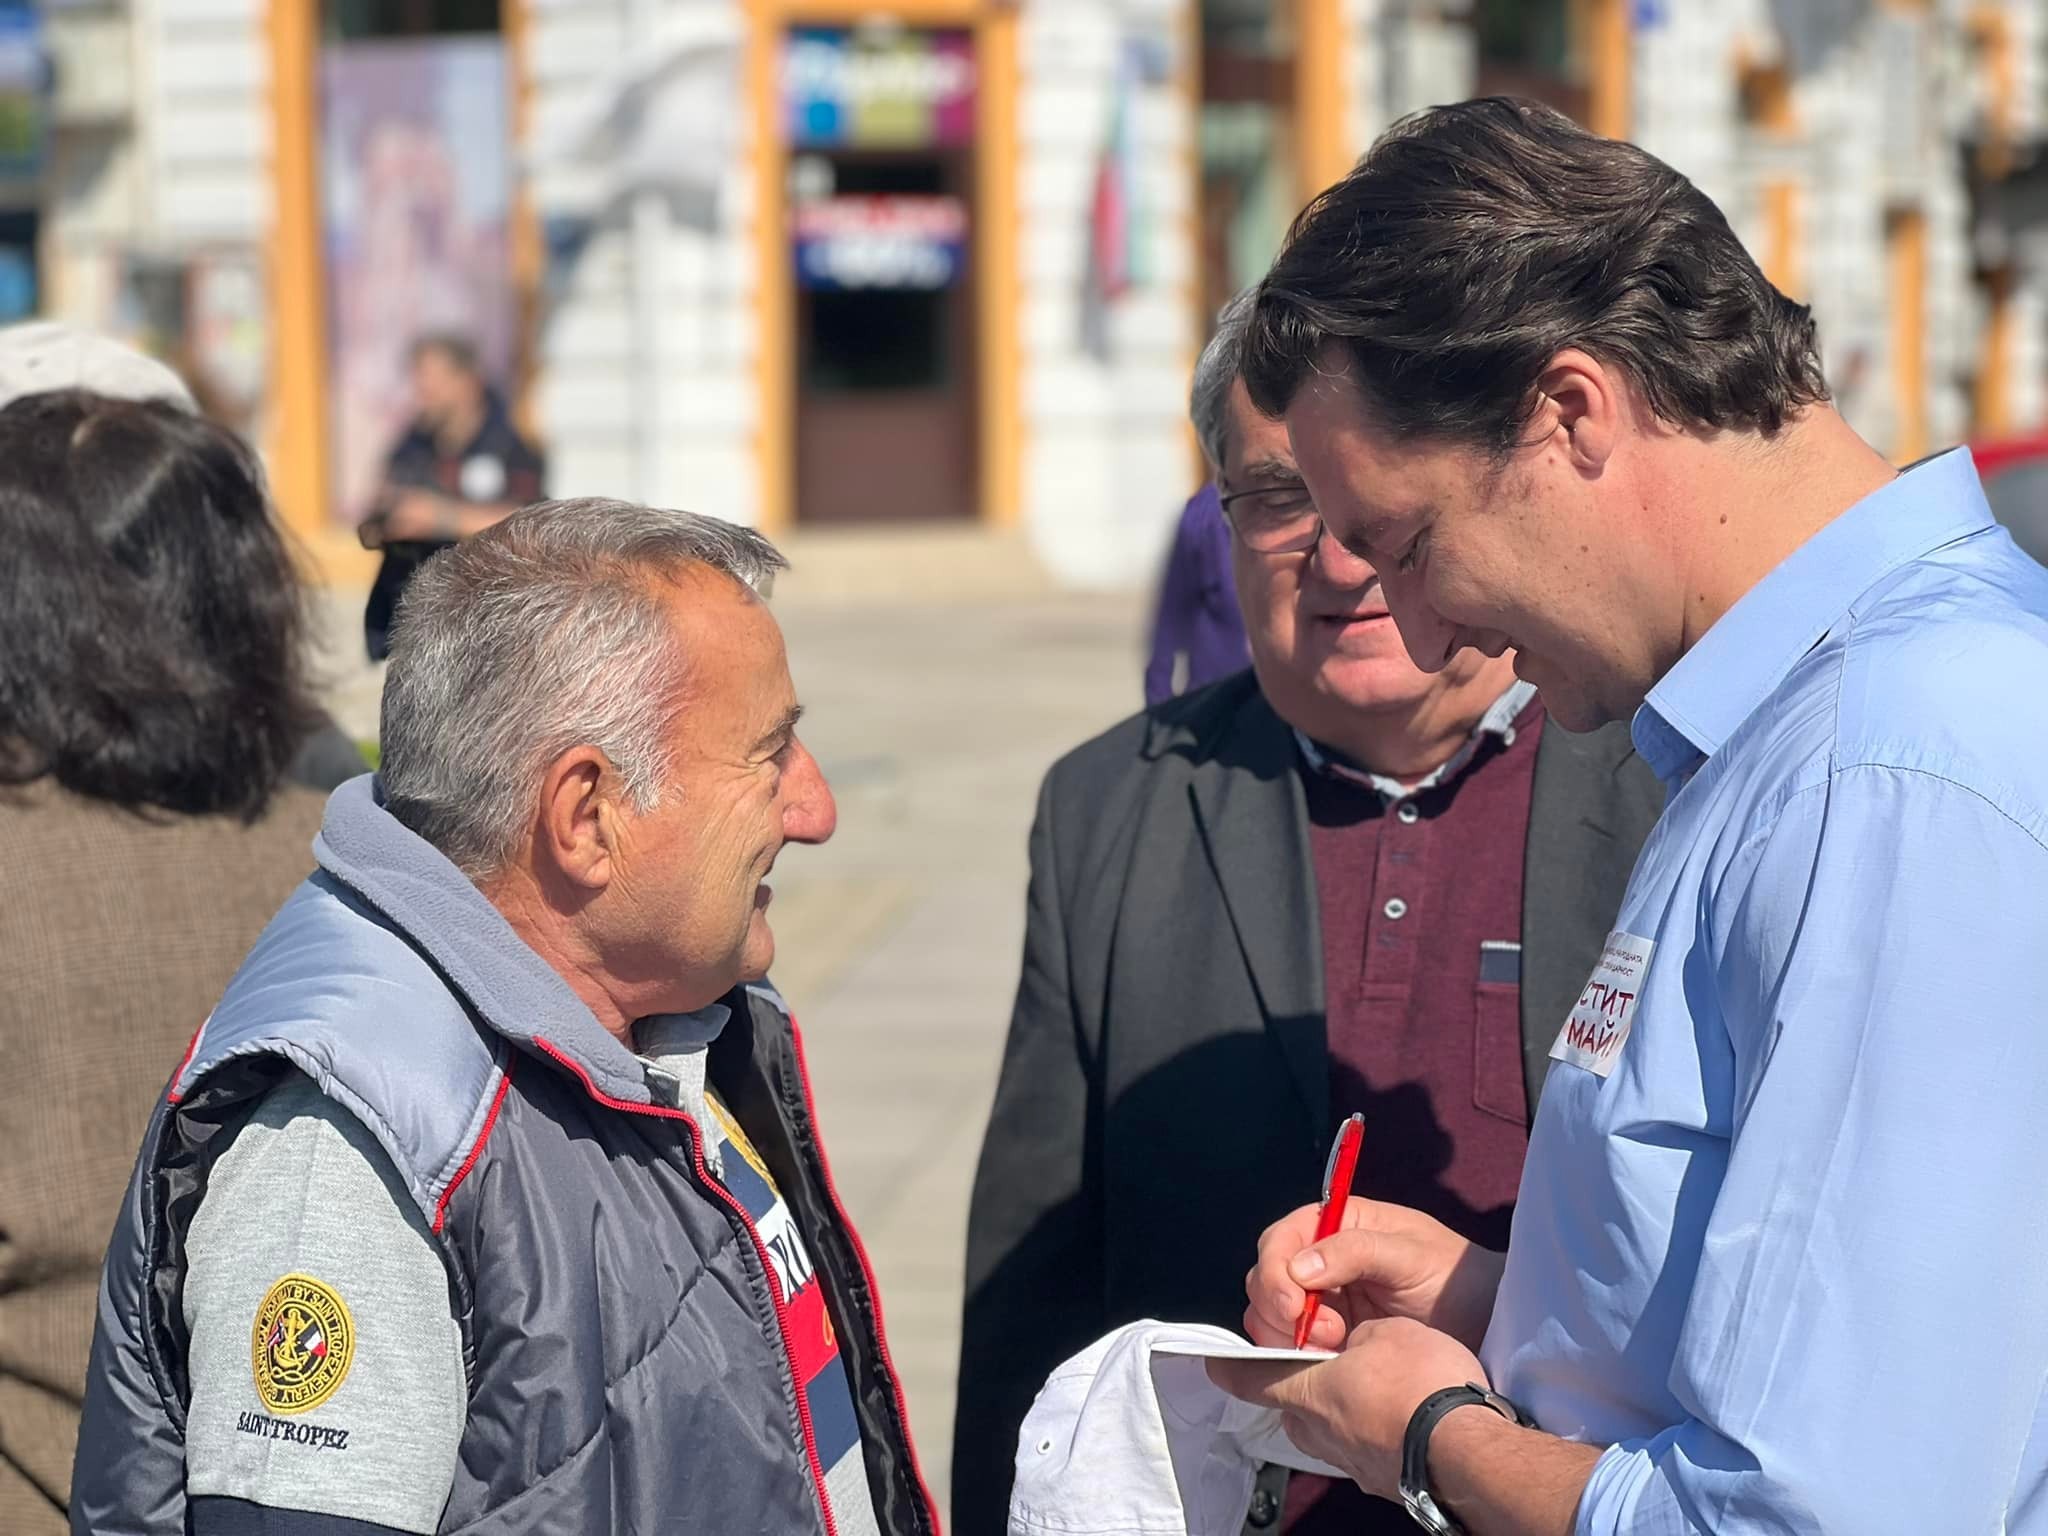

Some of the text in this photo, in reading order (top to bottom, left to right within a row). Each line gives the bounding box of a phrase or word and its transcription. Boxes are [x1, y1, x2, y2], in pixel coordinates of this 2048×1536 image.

[294, 1285, 311, 1301] BY
[309, 1294, 338, 1325] SAINT
[324, 1319, 344, 1376] TROPEZ
[280, 1373, 330, 1403] BEVERLY
[237, 1411, 349, 1451] SAINT TROPEZ
